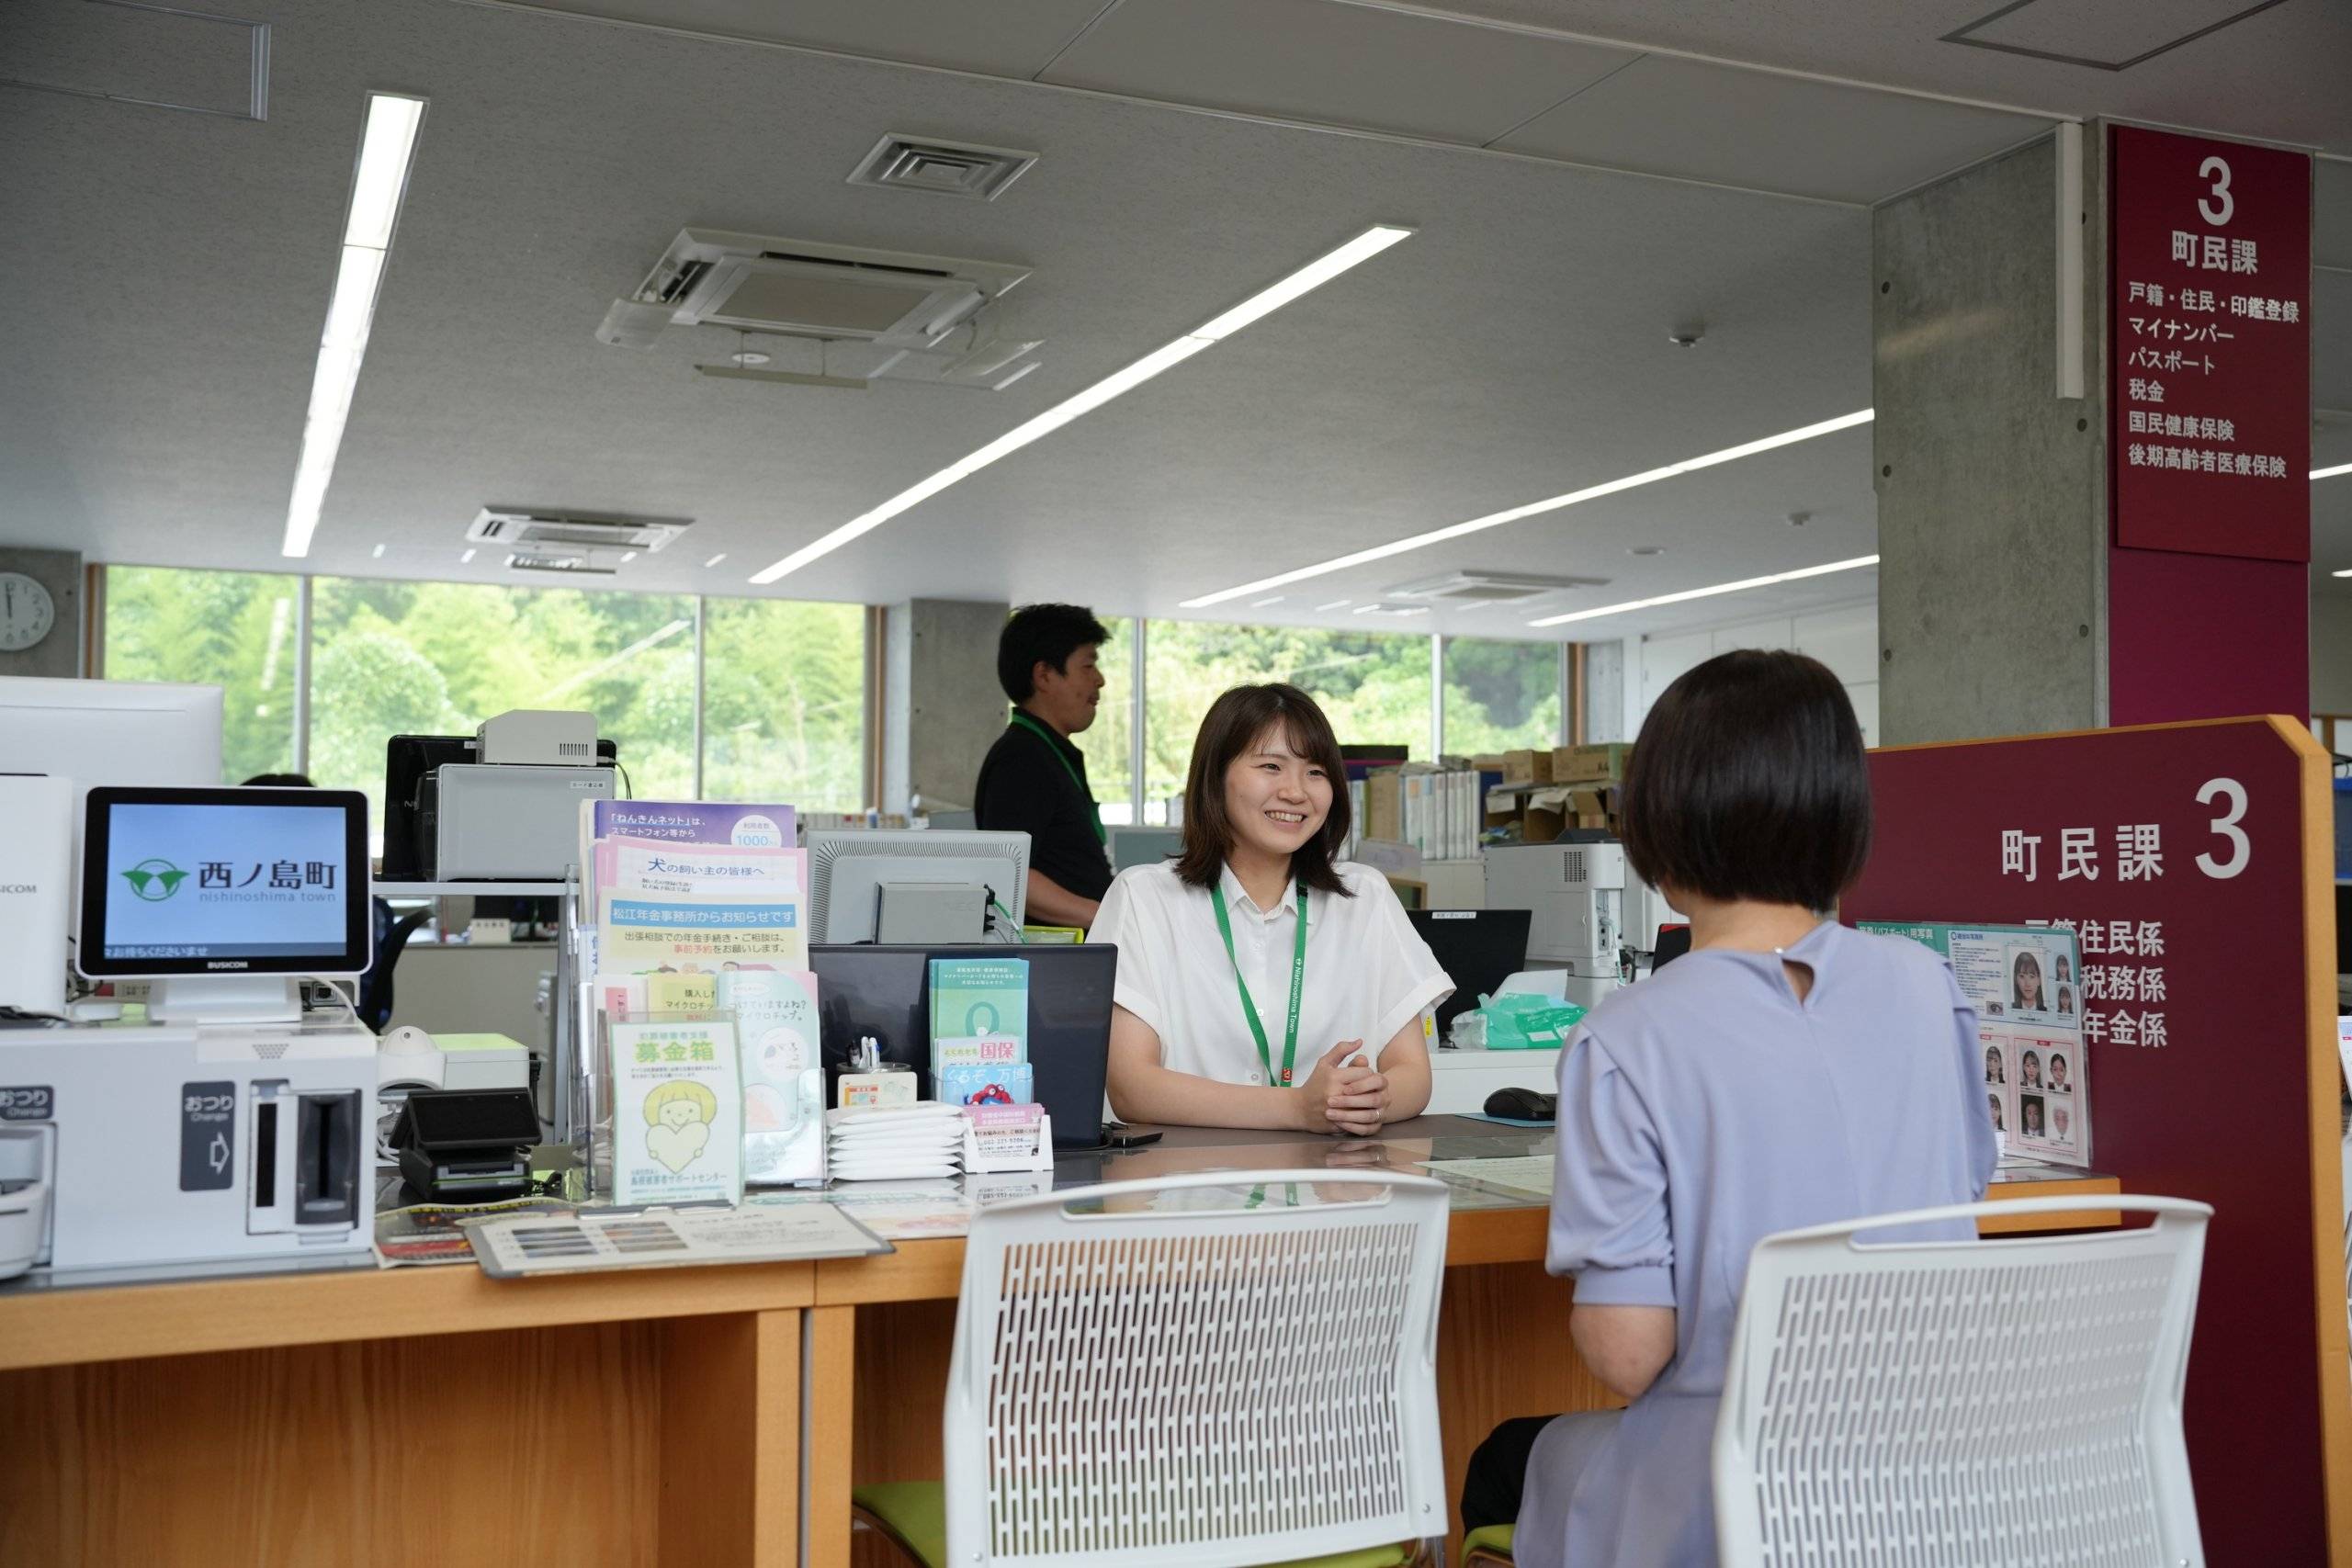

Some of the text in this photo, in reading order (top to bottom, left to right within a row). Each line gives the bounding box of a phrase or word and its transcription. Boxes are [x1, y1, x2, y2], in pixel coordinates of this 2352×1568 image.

[2198, 156, 2234, 226] 3
[2172, 230, 2258, 275] 町民課
[2129, 281, 2300, 323] 戸籍・住民・印鑑登録
[2129, 317, 2234, 343] マイナンバー
[2129, 351, 2215, 375] パスポート
[2129, 378, 2165, 402] 税金
[2129, 411, 2235, 442] 国民健康保険
[2129, 444, 2287, 479] 後期高齢者医療保険
[2195, 777, 2251, 879] 3
[648, 858, 765, 876] 犬の飼い主の皆様へ
[2001, 824, 2164, 882] 町民課
[0, 885, 37, 893] ICOM
[198, 860, 337, 889] 西ノ島町
[199, 892, 336, 903] nishinoshima town
[614, 908, 794, 923] 松江年金事務所からお知らせです
[2080, 964, 2166, 1002] 税務係
[1288, 966, 1301, 1033] Nishinoshima Town
[2081, 1009, 2167, 1047] 年金係
[636, 1041, 714, 1063] 募金箱
[980, 1043, 1015, 1058] 国保
[184, 1095, 234, 1112] おつり
